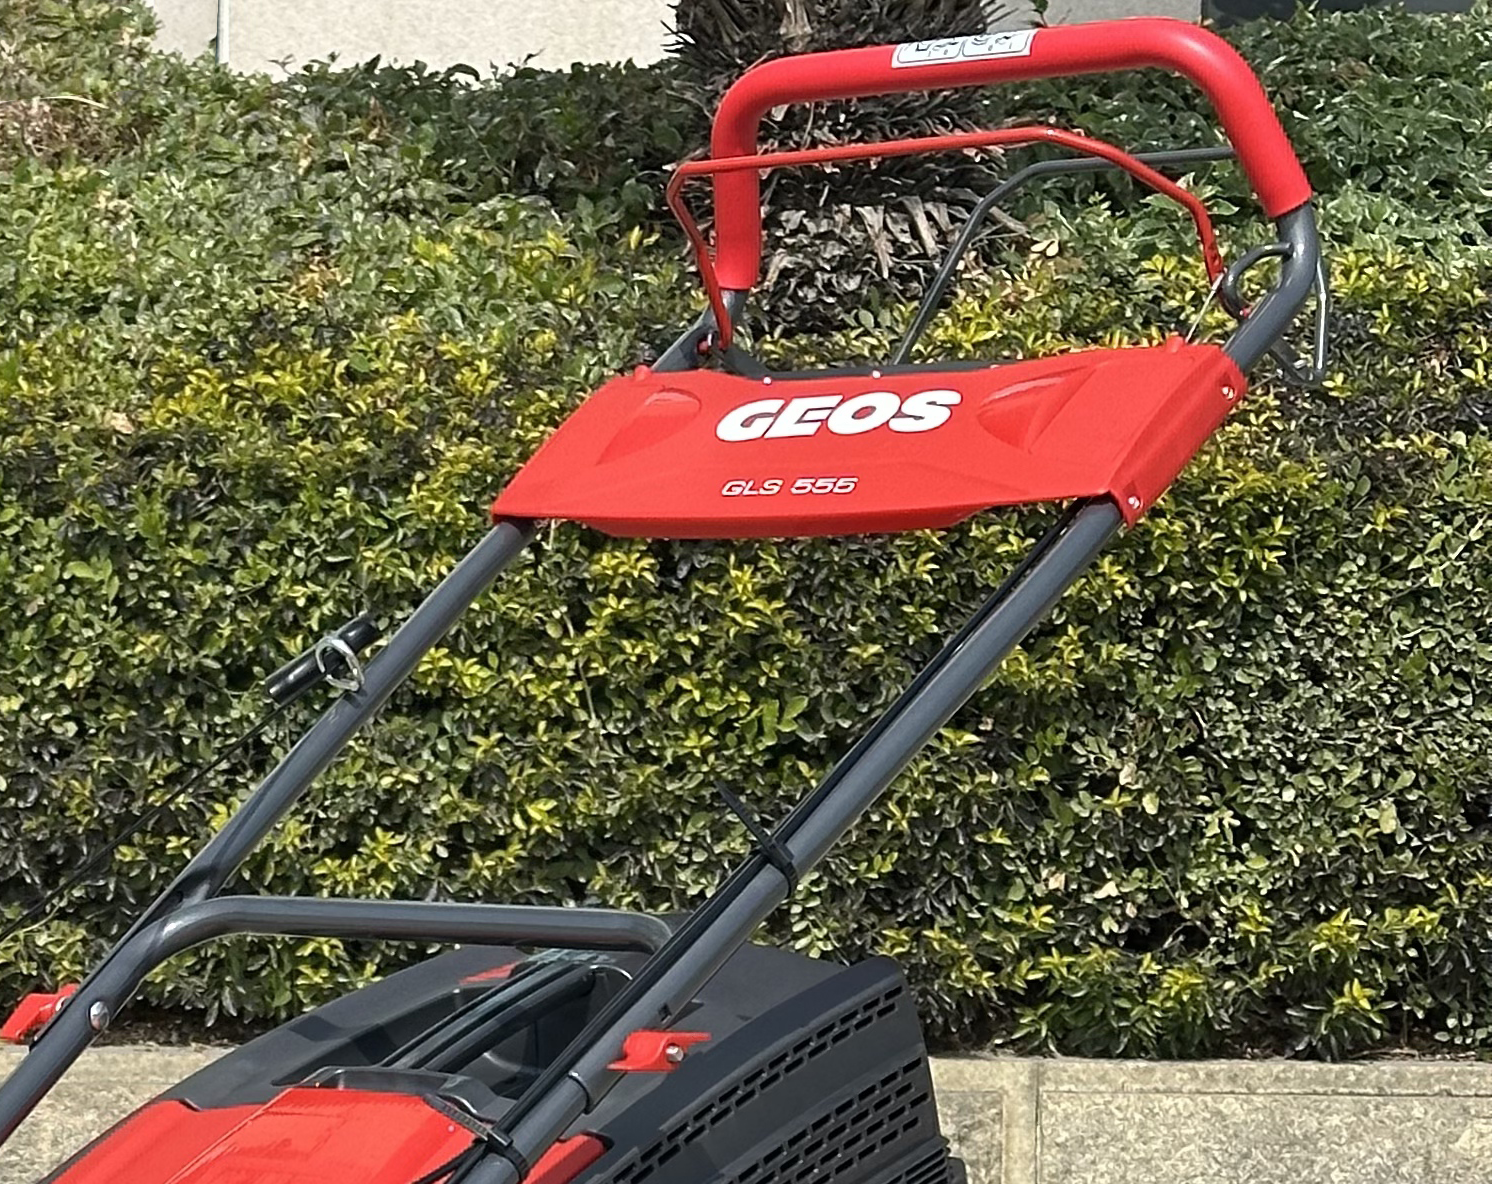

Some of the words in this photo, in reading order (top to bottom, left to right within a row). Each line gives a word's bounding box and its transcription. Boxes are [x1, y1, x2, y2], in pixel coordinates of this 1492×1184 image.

[715, 389, 962, 442] GEOS
[721, 479, 783, 496] GLS
[790, 477, 858, 494] 555
